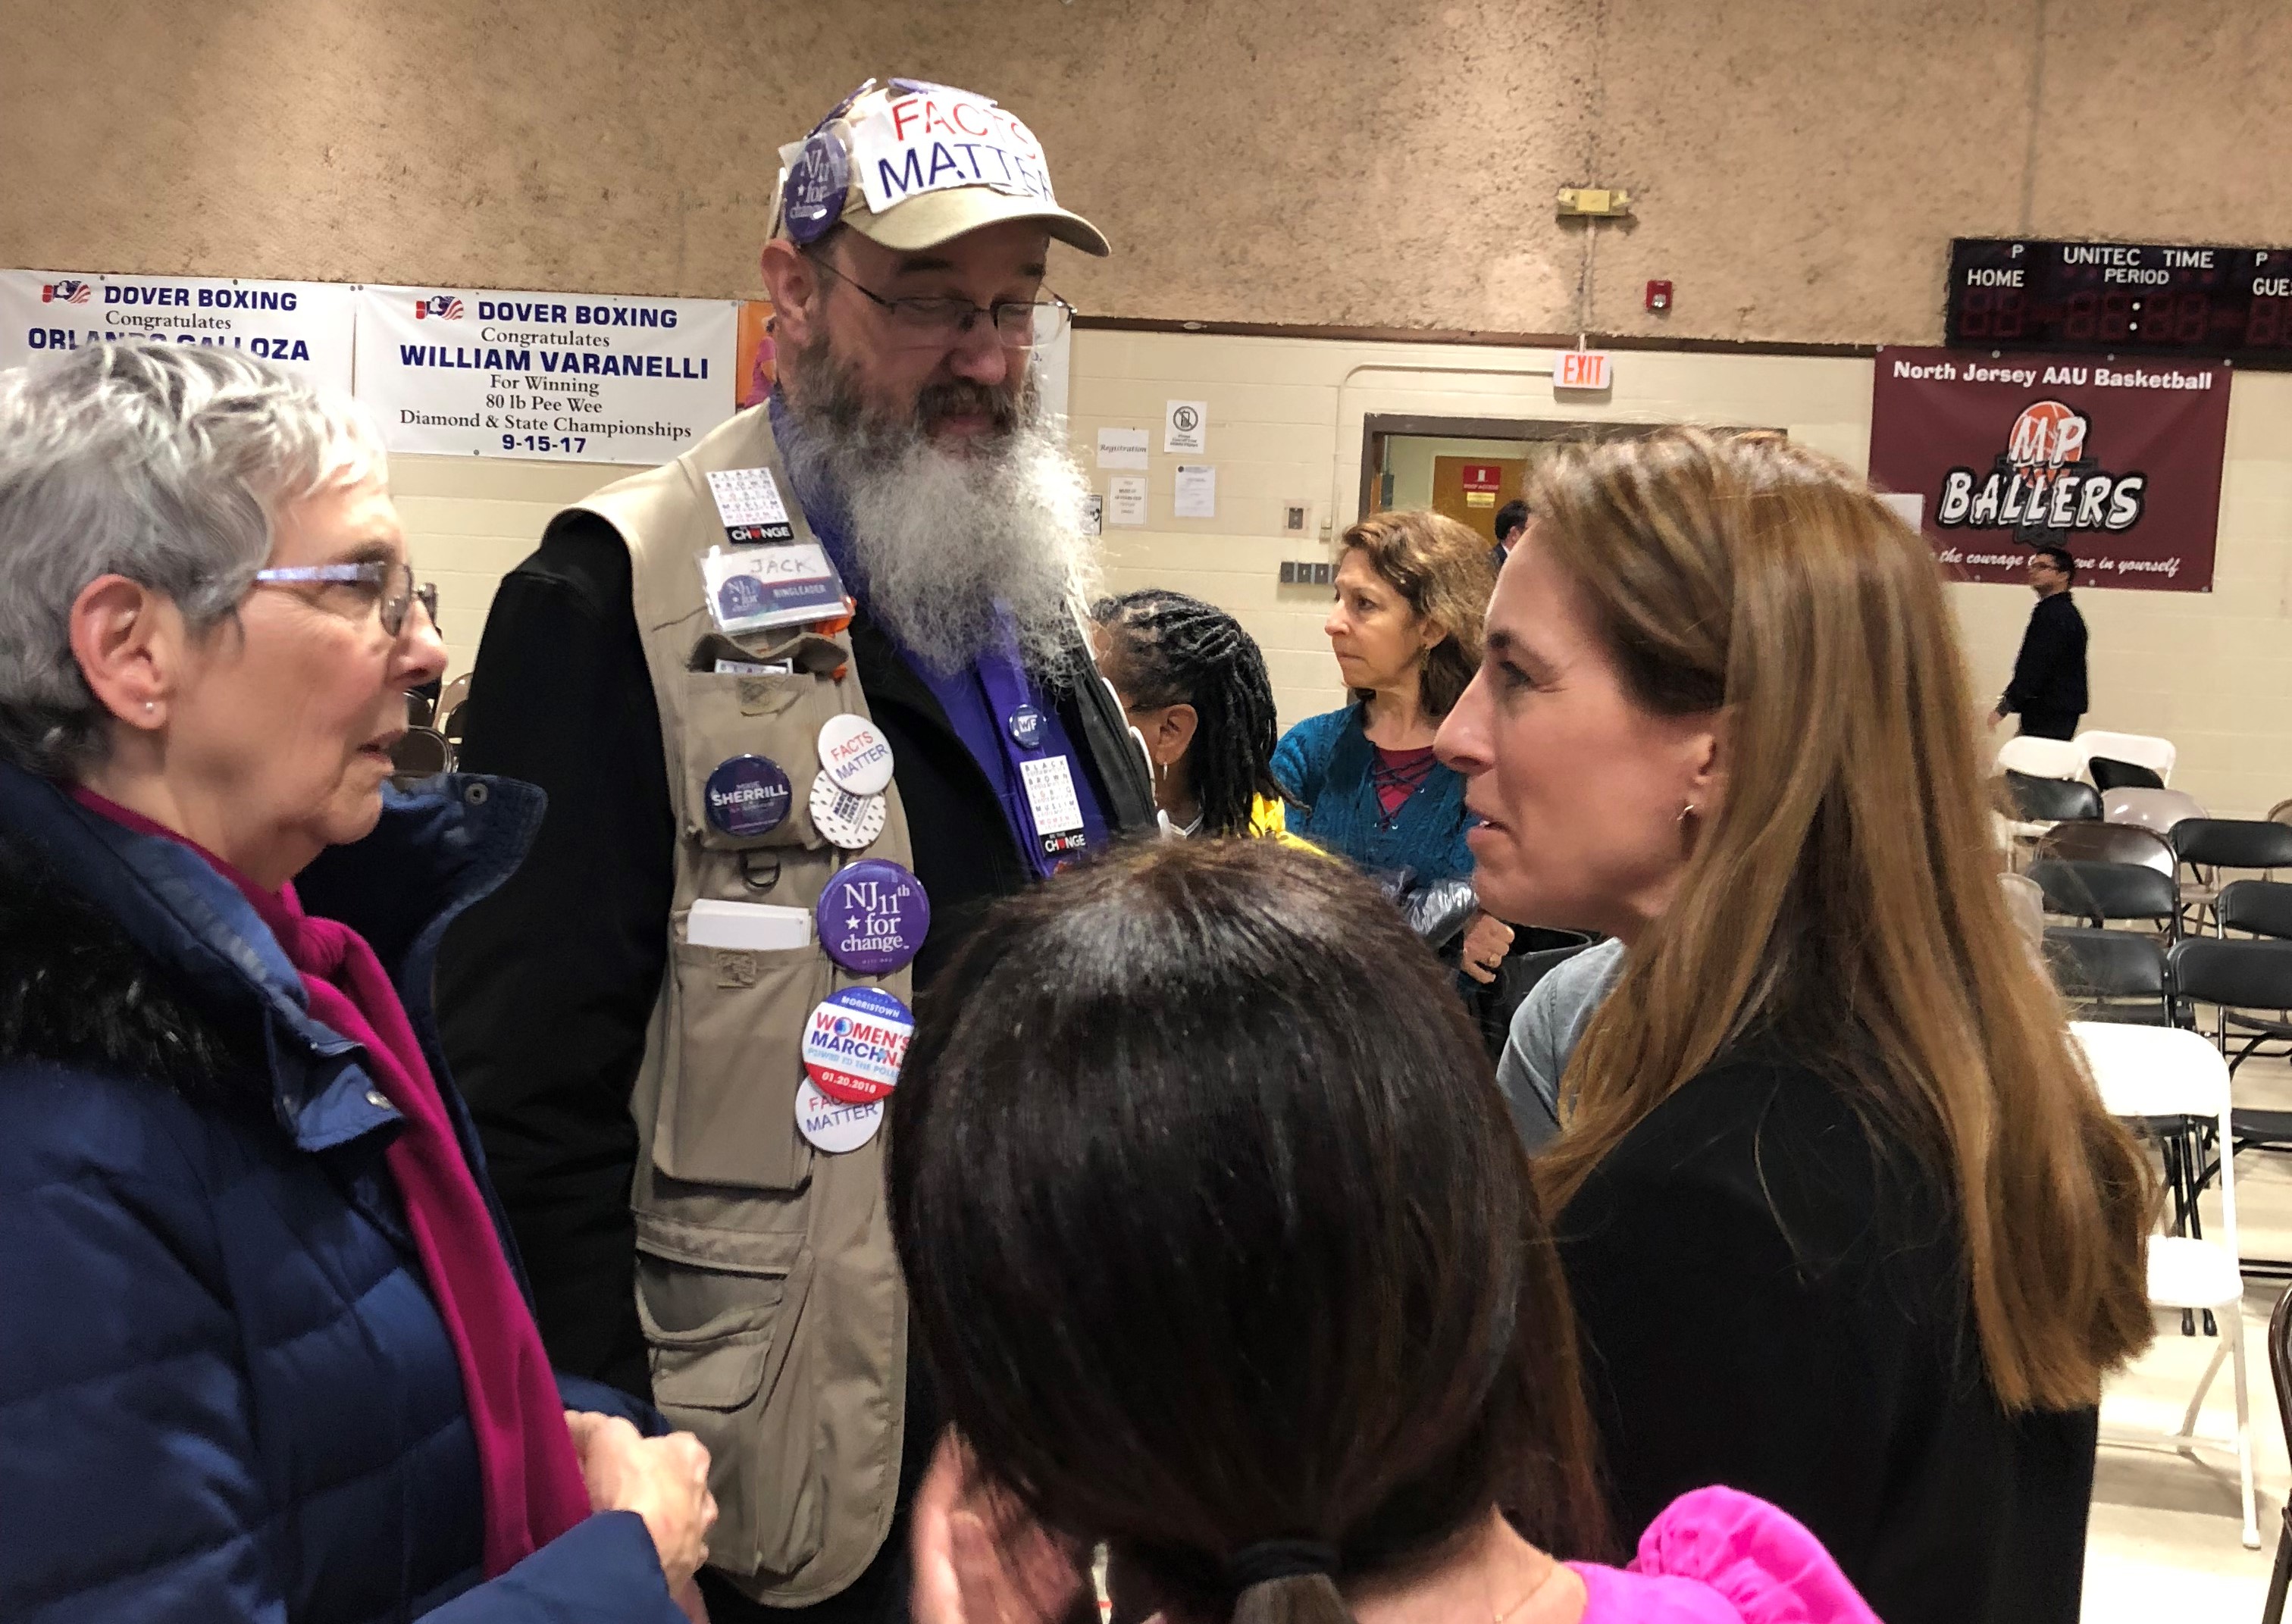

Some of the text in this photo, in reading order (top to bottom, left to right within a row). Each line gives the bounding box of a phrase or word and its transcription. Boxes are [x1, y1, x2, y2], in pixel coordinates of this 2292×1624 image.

[891, 99, 1036, 159] FACTS
[2011, 244, 2024, 259] P
[2063, 246, 2214, 269] UNITEC TIME
[2256, 251, 2269, 267] P
[1967, 269, 2024, 288] HOME
[2104, 268, 2170, 285] PERIOD
[2252, 277, 2292, 296] GUE
[105, 285, 297, 311] DOVER BOXING
[105, 310, 231, 330] Congratulates
[478, 301, 678, 328] DOVER BOXING
[28, 327, 167, 350] ORLA
[481, 327, 611, 348] Congratulates
[400, 344, 709, 380] WILLIAM VARANELLI
[1564, 355, 1604, 386] EXIT
[490, 374, 600, 396] For Winning
[1893, 361, 2212, 390] North Jersey AAU Basketball
[486, 394, 603, 414] 80 lb Pee Wee
[400, 409, 692, 441] Diamond & State Championships
[503, 434, 587, 453] 9-15-17
[1100, 444, 1147, 453] Registration
[2009, 415, 2088, 468] MP
[1940, 471, 2145, 530] BALLERS
[750, 555, 817, 574] JACK
[1939, 547, 1963, 563] the
[1966, 554, 2023, 570] courage
[2099, 557, 2115, 570] in
[2118, 557, 2181, 578] yourself
[831, 731, 874, 762] FACTS
[835, 743, 889, 781] MATTER
[711, 784, 789, 806] SHERRILL
[865, 912, 902, 937] for
[841, 995, 900, 1019] MORRISTOWN
[816, 1012, 910, 1052] WOMEN'S
[810, 1031, 881, 1063] MARCH
[822, 1071, 877, 1094] 01.20.2018
[806, 1103, 878, 1133] MATTER
